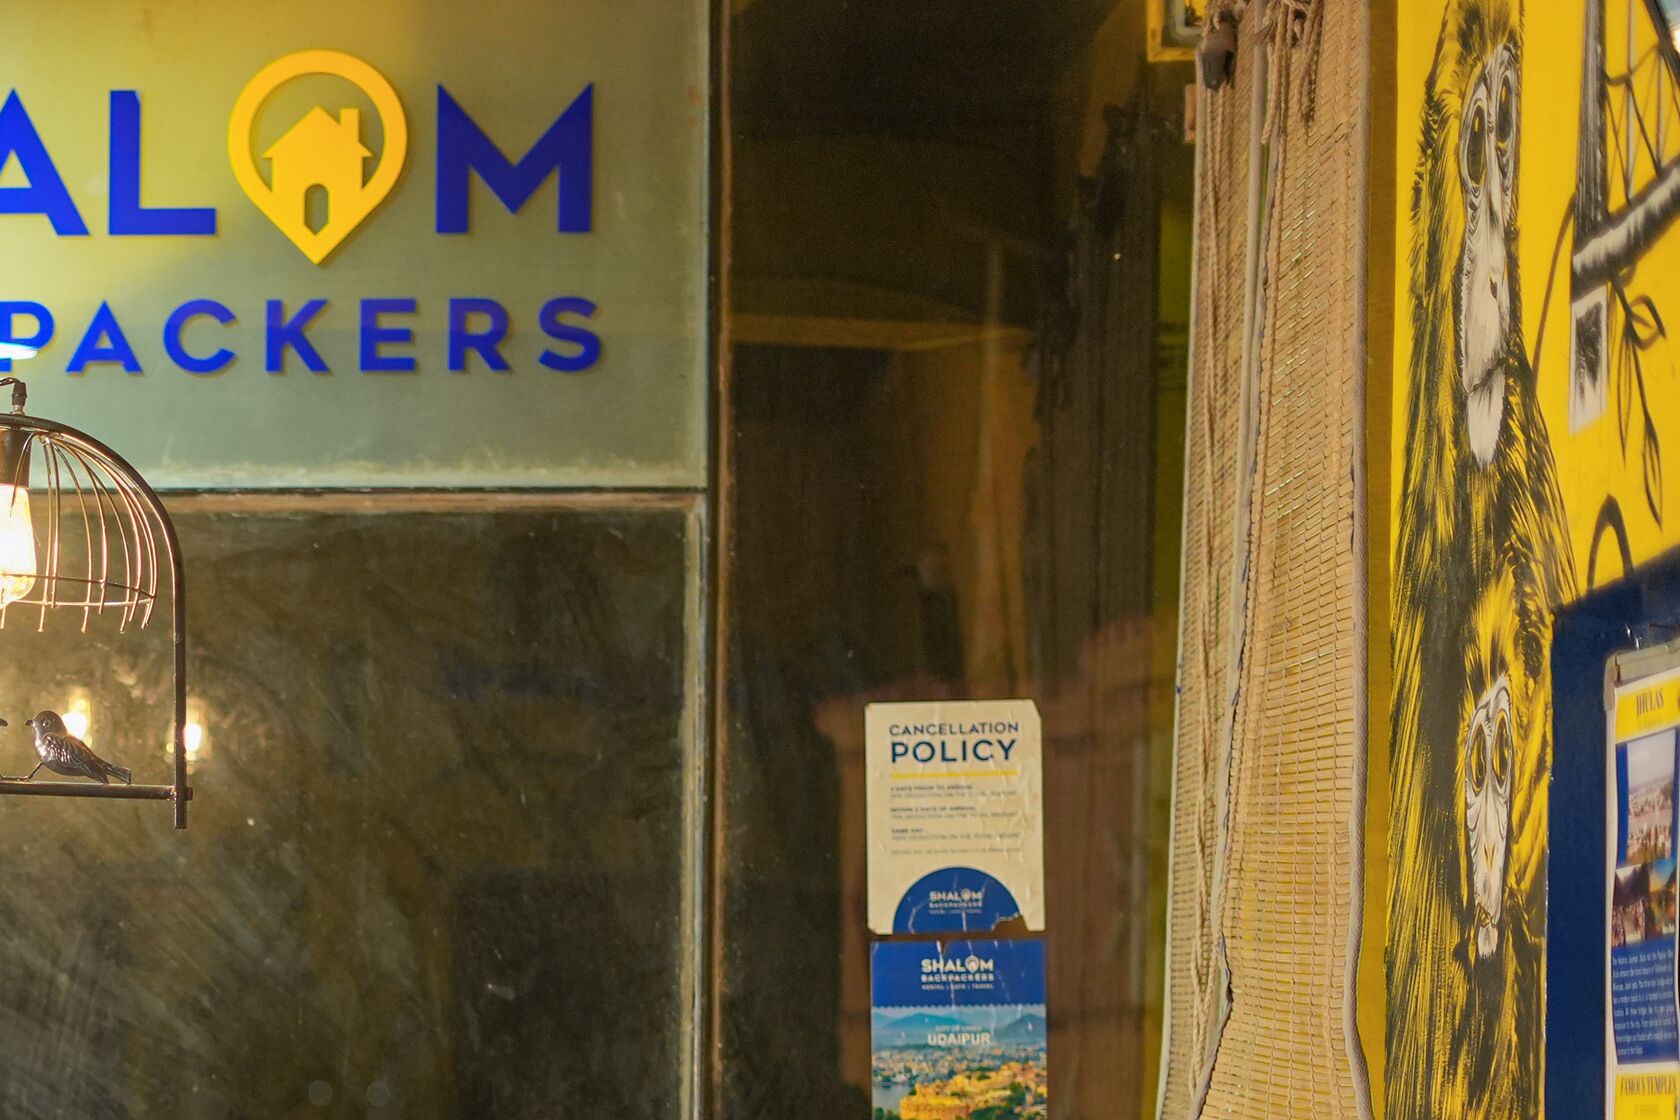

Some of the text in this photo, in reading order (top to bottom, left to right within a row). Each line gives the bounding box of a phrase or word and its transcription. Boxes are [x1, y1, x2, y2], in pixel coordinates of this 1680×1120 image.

[889, 721, 1019, 736] CANCELLATION
[891, 739, 1017, 764] POLICY
[921, 955, 994, 973] SHALOM
[927, 1032, 990, 1047] UDAIPUR
